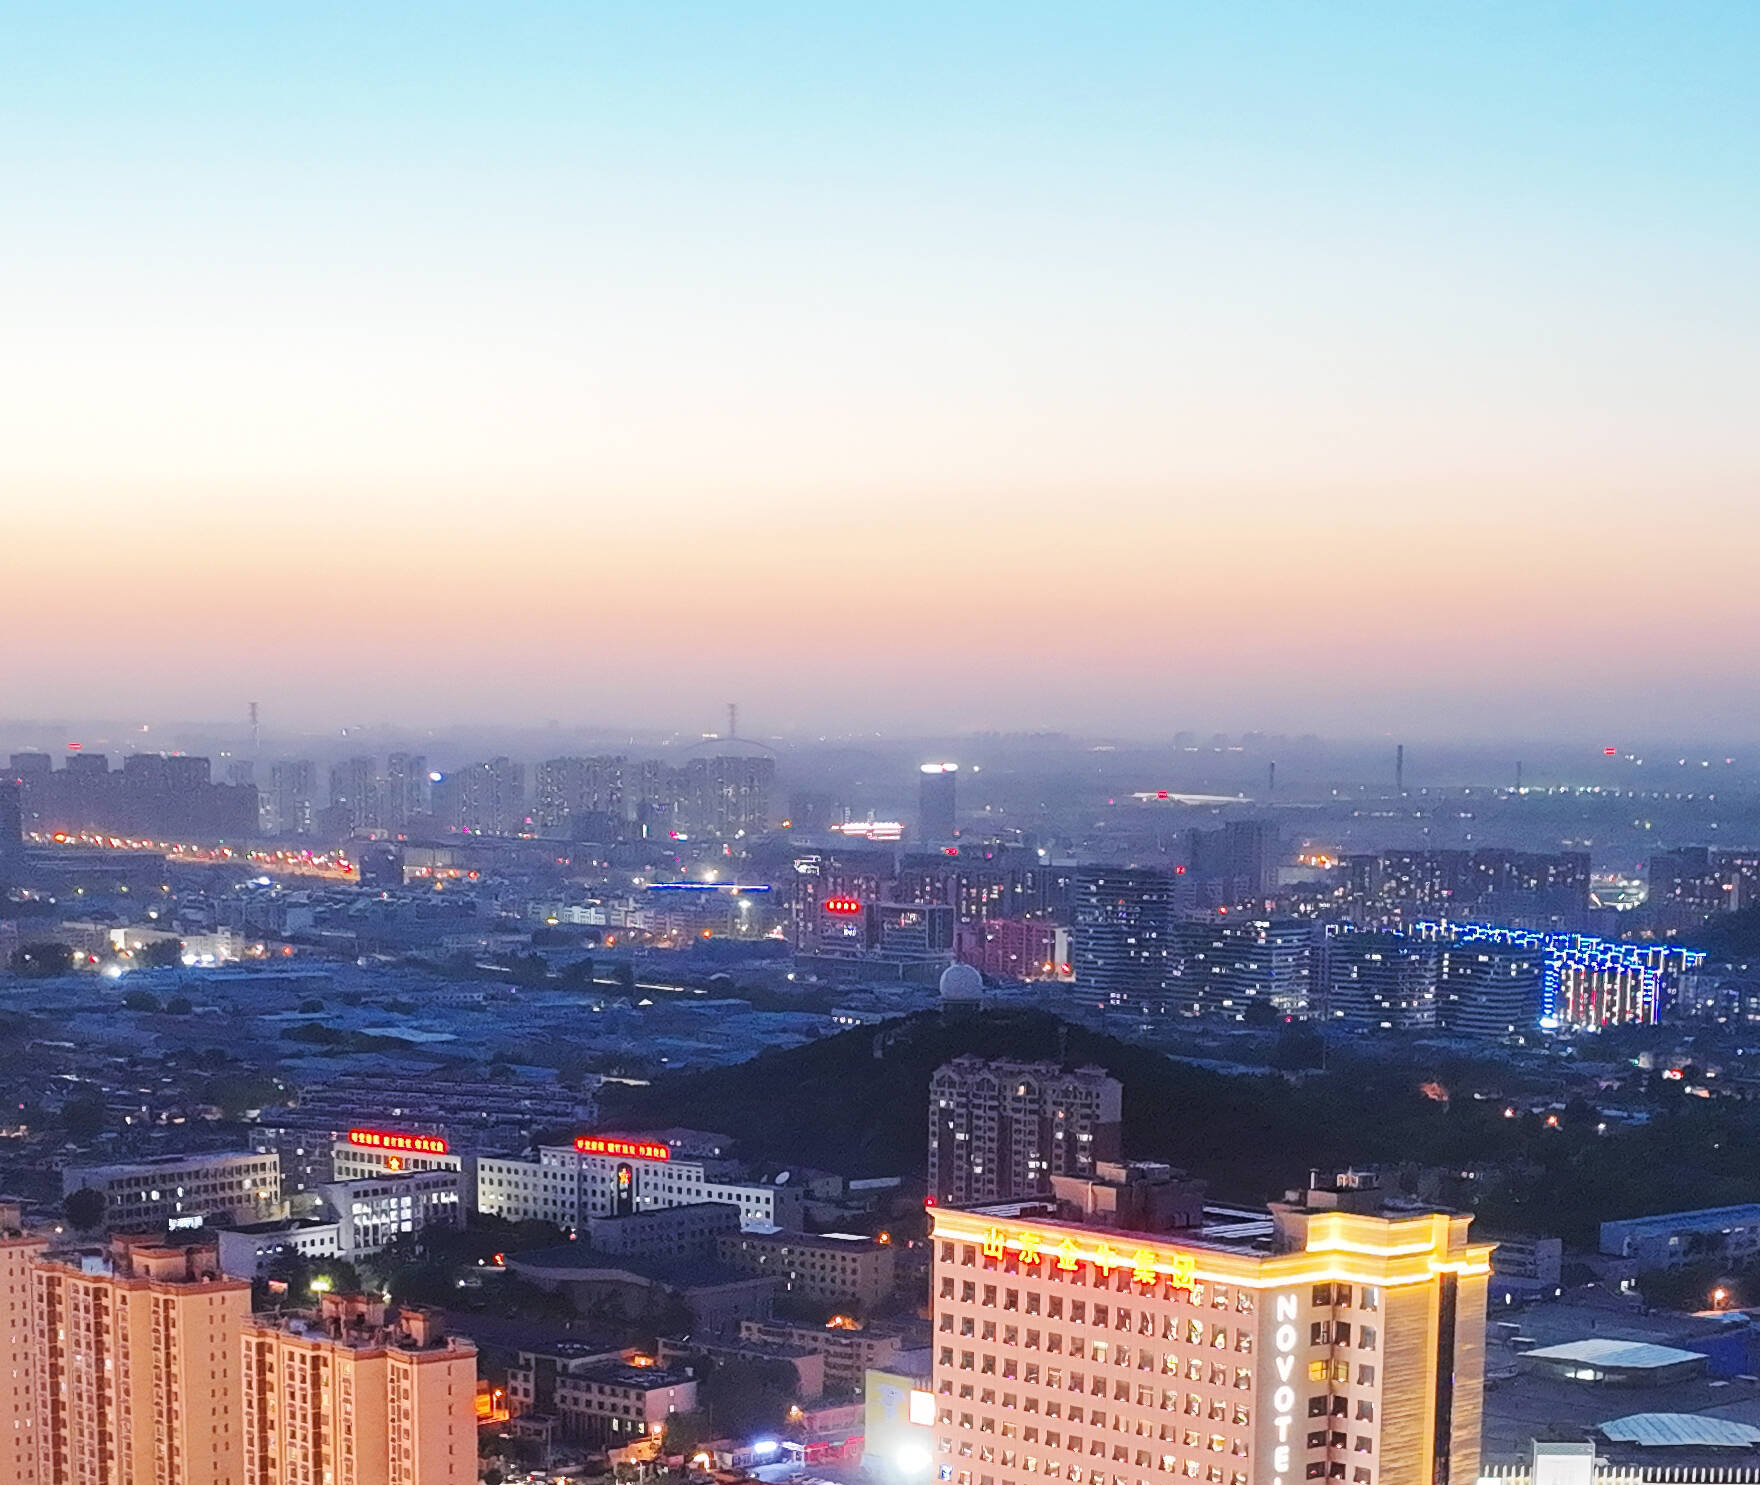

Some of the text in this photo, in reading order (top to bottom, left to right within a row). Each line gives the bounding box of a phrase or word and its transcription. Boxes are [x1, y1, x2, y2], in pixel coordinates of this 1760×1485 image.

[983, 1227, 1196, 1292] 山东金牛集团
